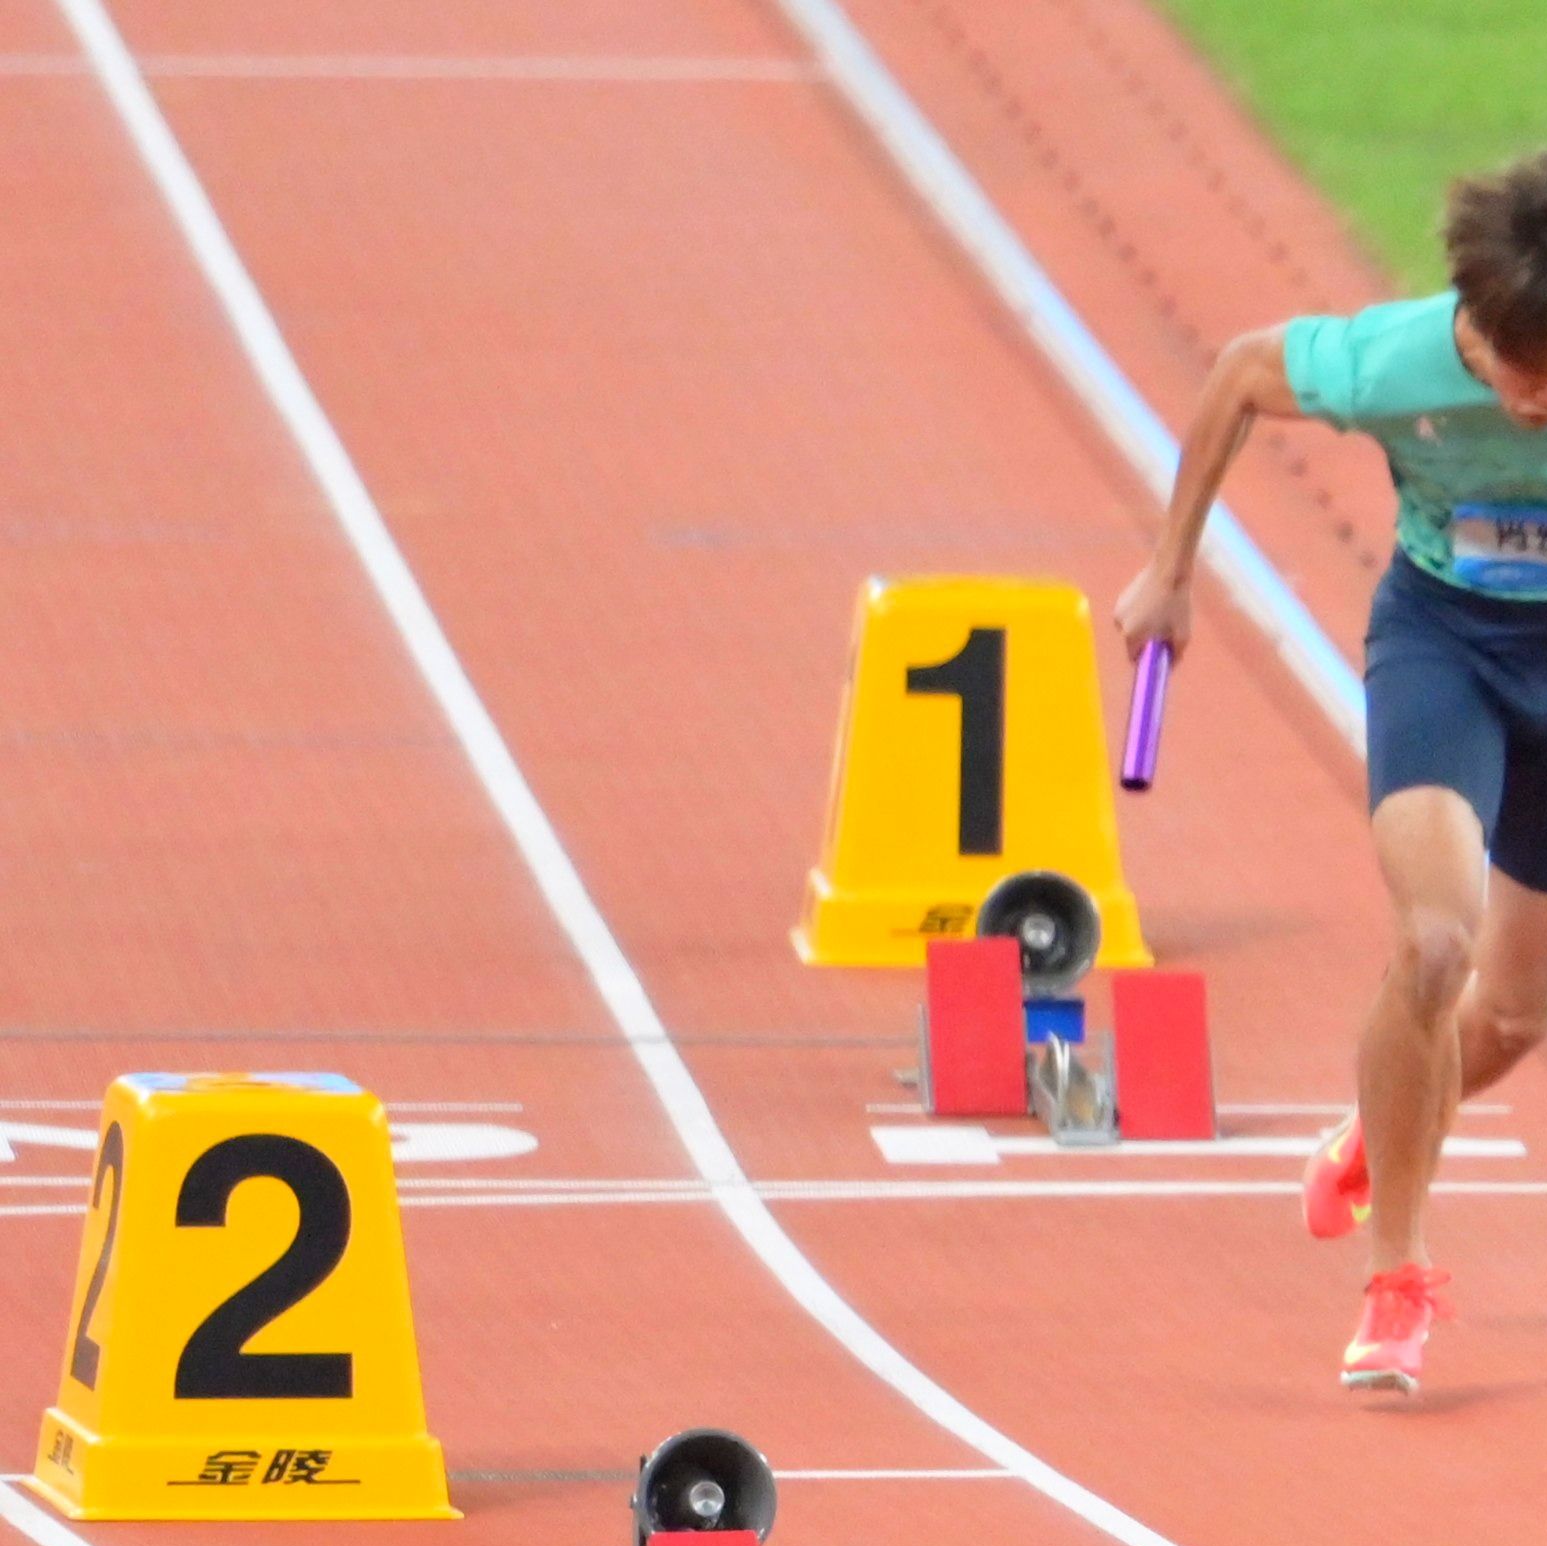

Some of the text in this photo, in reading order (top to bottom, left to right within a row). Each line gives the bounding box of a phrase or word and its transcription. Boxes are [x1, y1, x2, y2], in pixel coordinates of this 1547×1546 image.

[905, 628, 1005, 855] 1
[70, 1120, 123, 1391] 2
[174, 1134, 352, 1399] 2
[180, 1449, 348, 1486] 金陵
